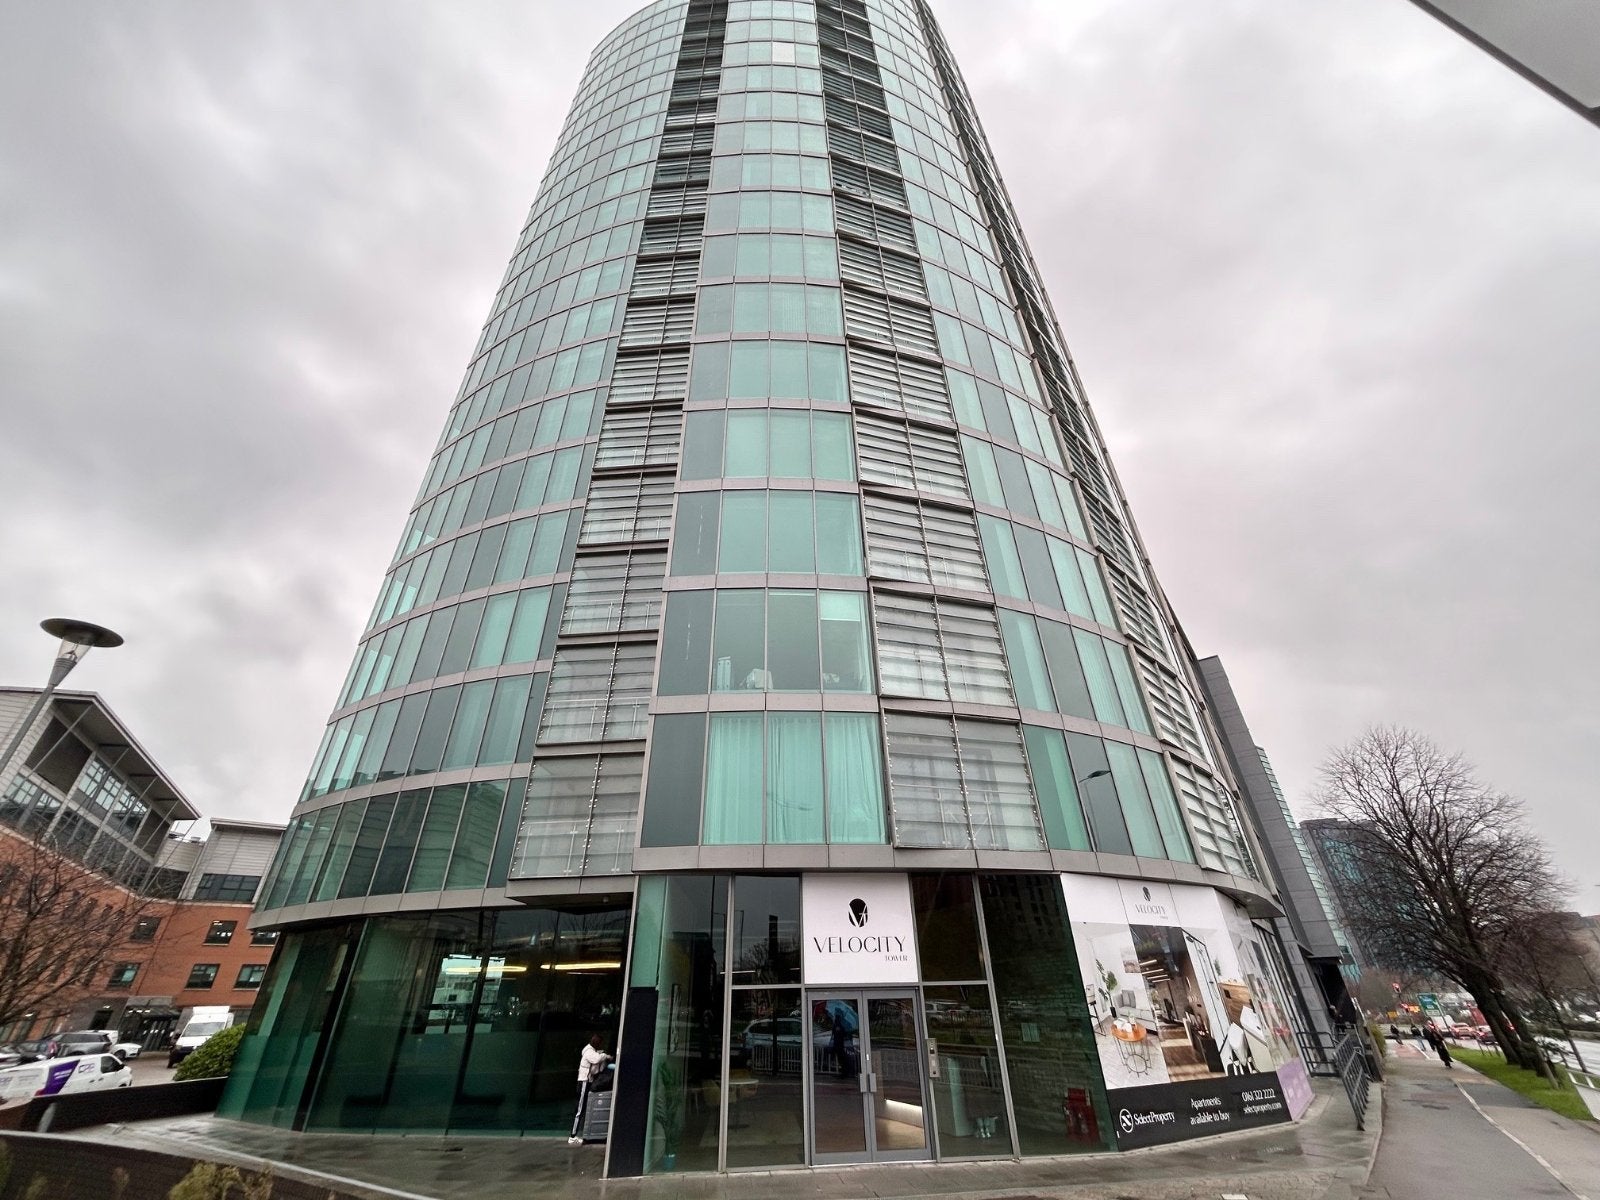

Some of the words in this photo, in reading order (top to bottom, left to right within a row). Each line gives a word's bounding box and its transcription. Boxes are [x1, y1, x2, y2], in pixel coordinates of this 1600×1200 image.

[1135, 904, 1166, 914] VELOCITY
[814, 936, 905, 953] VELOCITY
[1190, 1097, 1222, 1110] Apartments
[1190, 1112, 1213, 1125] available
[1212, 1112, 1220, 1122] to
[1219, 1110, 1231, 1122] buy
